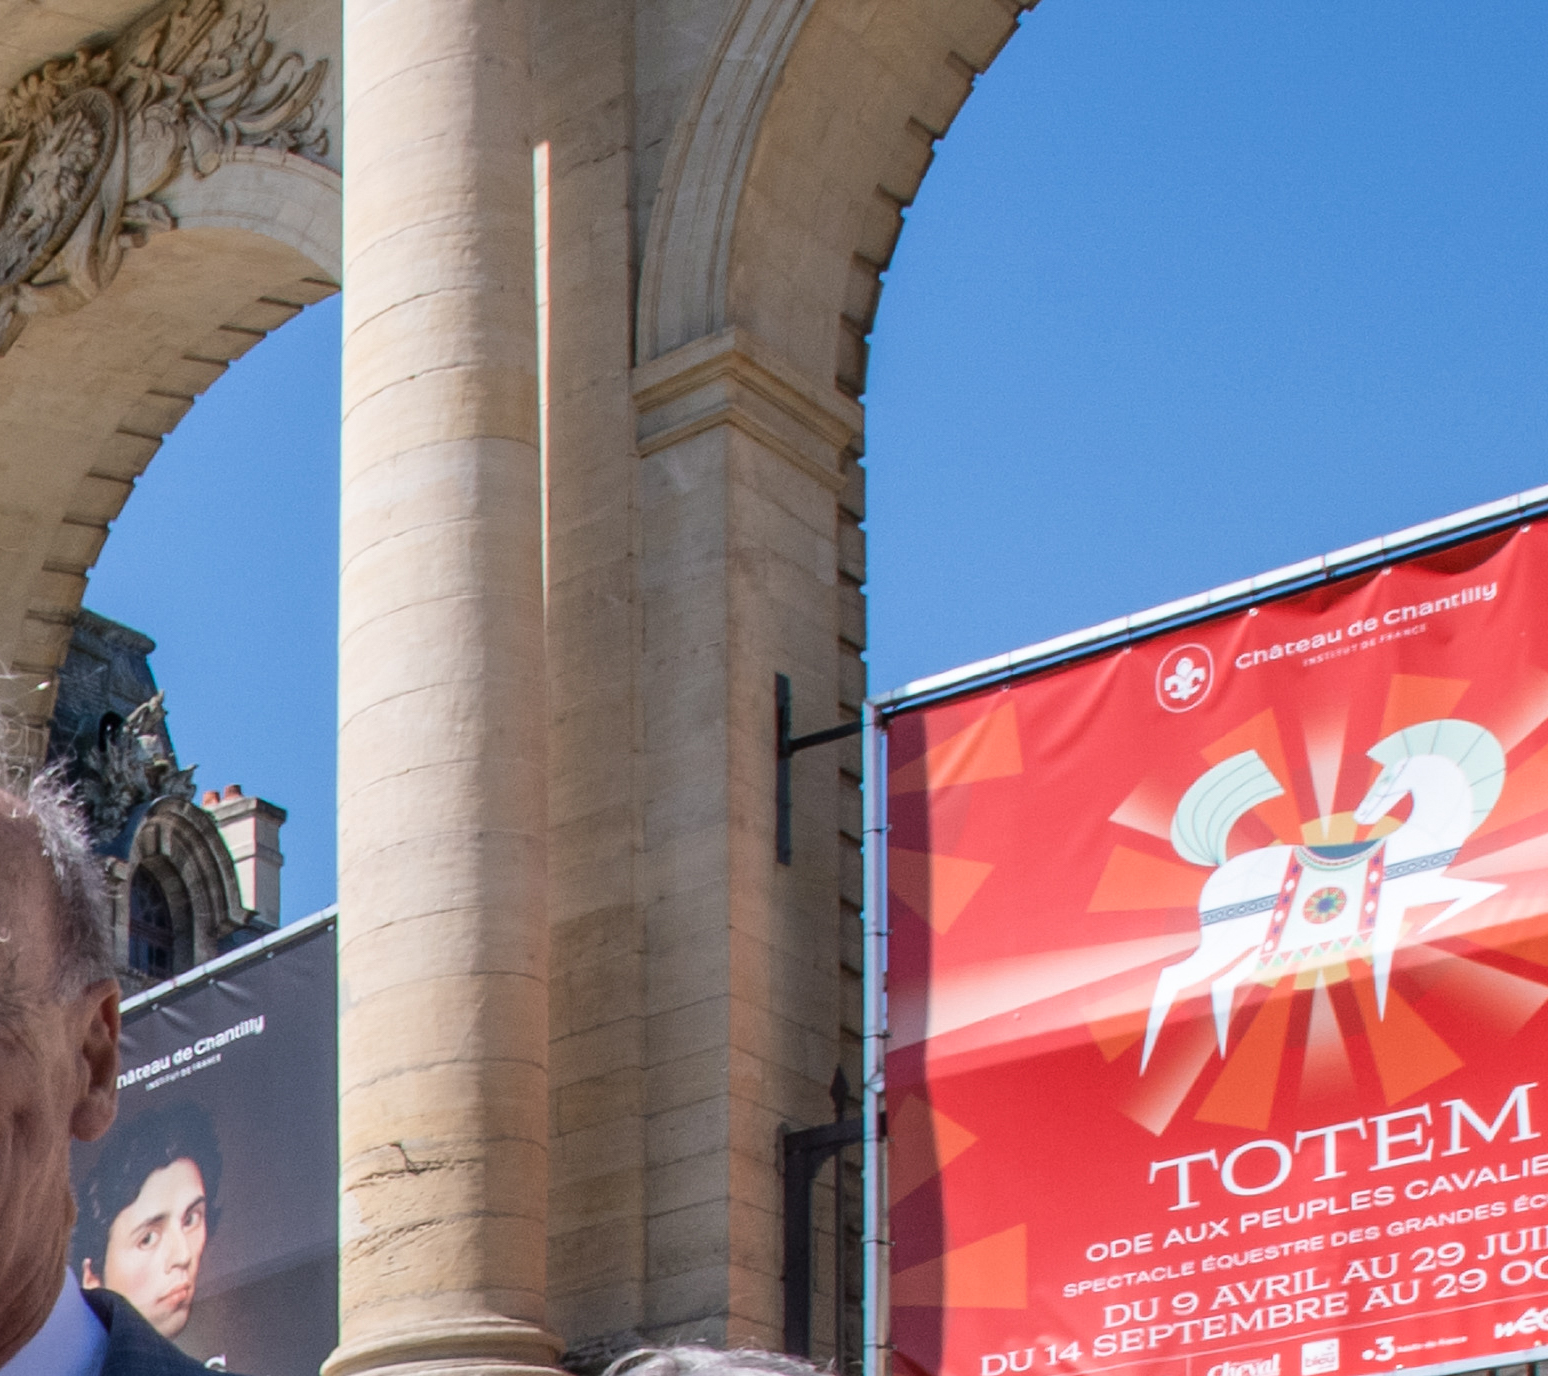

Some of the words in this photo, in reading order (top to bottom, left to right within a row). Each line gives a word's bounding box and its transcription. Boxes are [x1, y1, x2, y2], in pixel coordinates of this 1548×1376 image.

[1235, 626, 1342, 670] Château
[1348, 614, 1379, 639] de
[1383, 580, 1499, 626] Chantilly
[1359, 637, 1377, 651] DE
[1379, 623, 1427, 644] FRANCE
[116, 1055, 171, 1090] hâteau
[172, 1045, 194, 1066] de
[194, 1014, 266, 1056] Chantilly
[1148, 1081, 1542, 1212] TOTEM
[1062, 1260, 1196, 1298] SPECTACLE
[1201, 1234, 1325, 1273] ÉQUESTRE
[1331, 1223, 1381, 1248] DES
[1386, 1201, 1507, 1237] GRANDES
[1085, 1232, 1154, 1263] ODE
[1161, 1217, 1230, 1250] AUX
[1239, 1185, 1396, 1234] PEUPLES
[1044, 1341, 1083, 1367] 14
[1092, 1290, 1350, 1358] SEPTEMBRE
[1360, 1280, 1421, 1313] AU
[1433, 1268, 1488, 1300] 29
[1103, 1296, 1161, 1330] DU
[1170, 1291, 1199, 1316] 9
[1209, 1266, 1331, 1311] AVRIL
[1341, 1252, 1402, 1286] AU
[1409, 1241, 1466, 1273] 29
[1477, 1225, 1548, 1260] JUI
